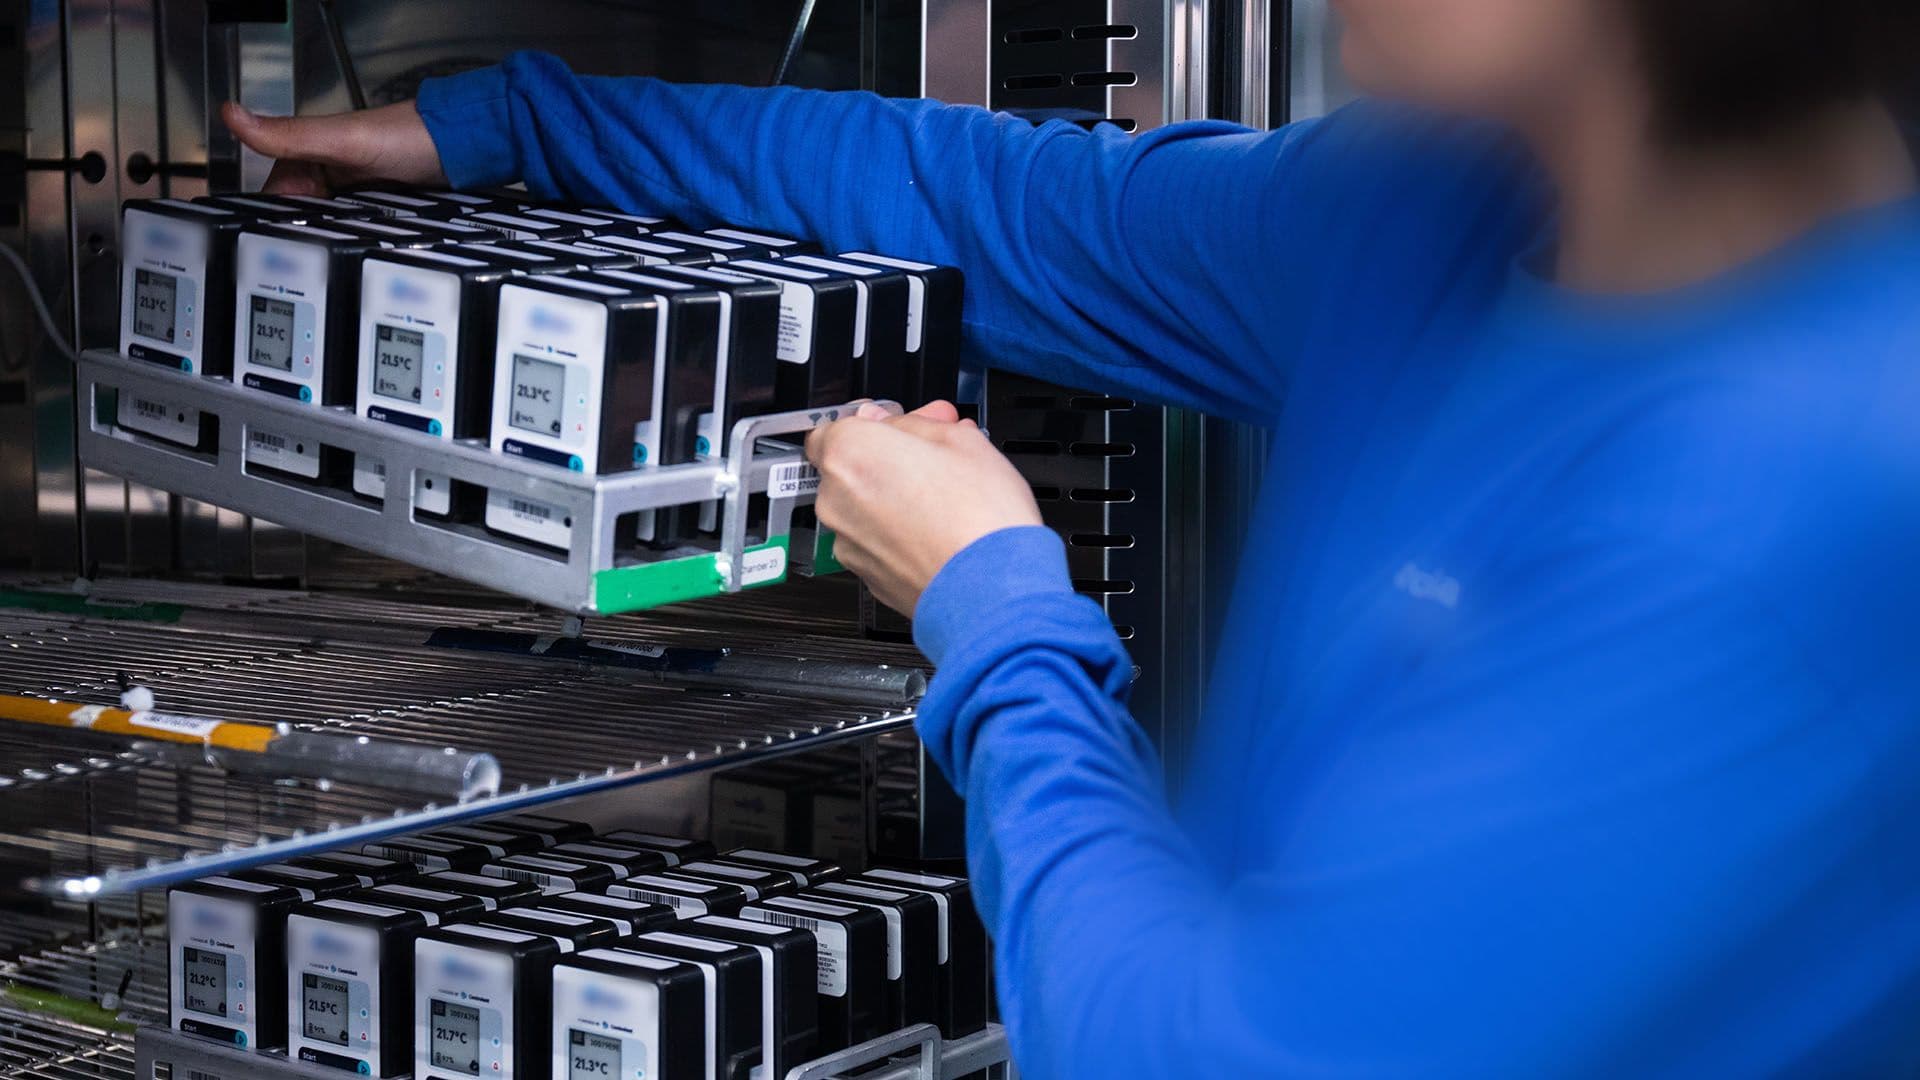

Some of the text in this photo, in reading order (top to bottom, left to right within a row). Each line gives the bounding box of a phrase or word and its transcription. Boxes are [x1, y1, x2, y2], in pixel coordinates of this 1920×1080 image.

[256, 323, 286, 341] 21.3°C
[381, 352, 412, 371] 21.5°C
[516, 383, 550, 402] 21.3°C
[780, 481, 797, 492] CMS
[189, 973, 217, 989] 21.2°C
[308, 999, 338, 1016] 21.5°C
[436, 1027, 468, 1044] 21.7°C
[574, 1056, 609, 1076] 21.3°C
